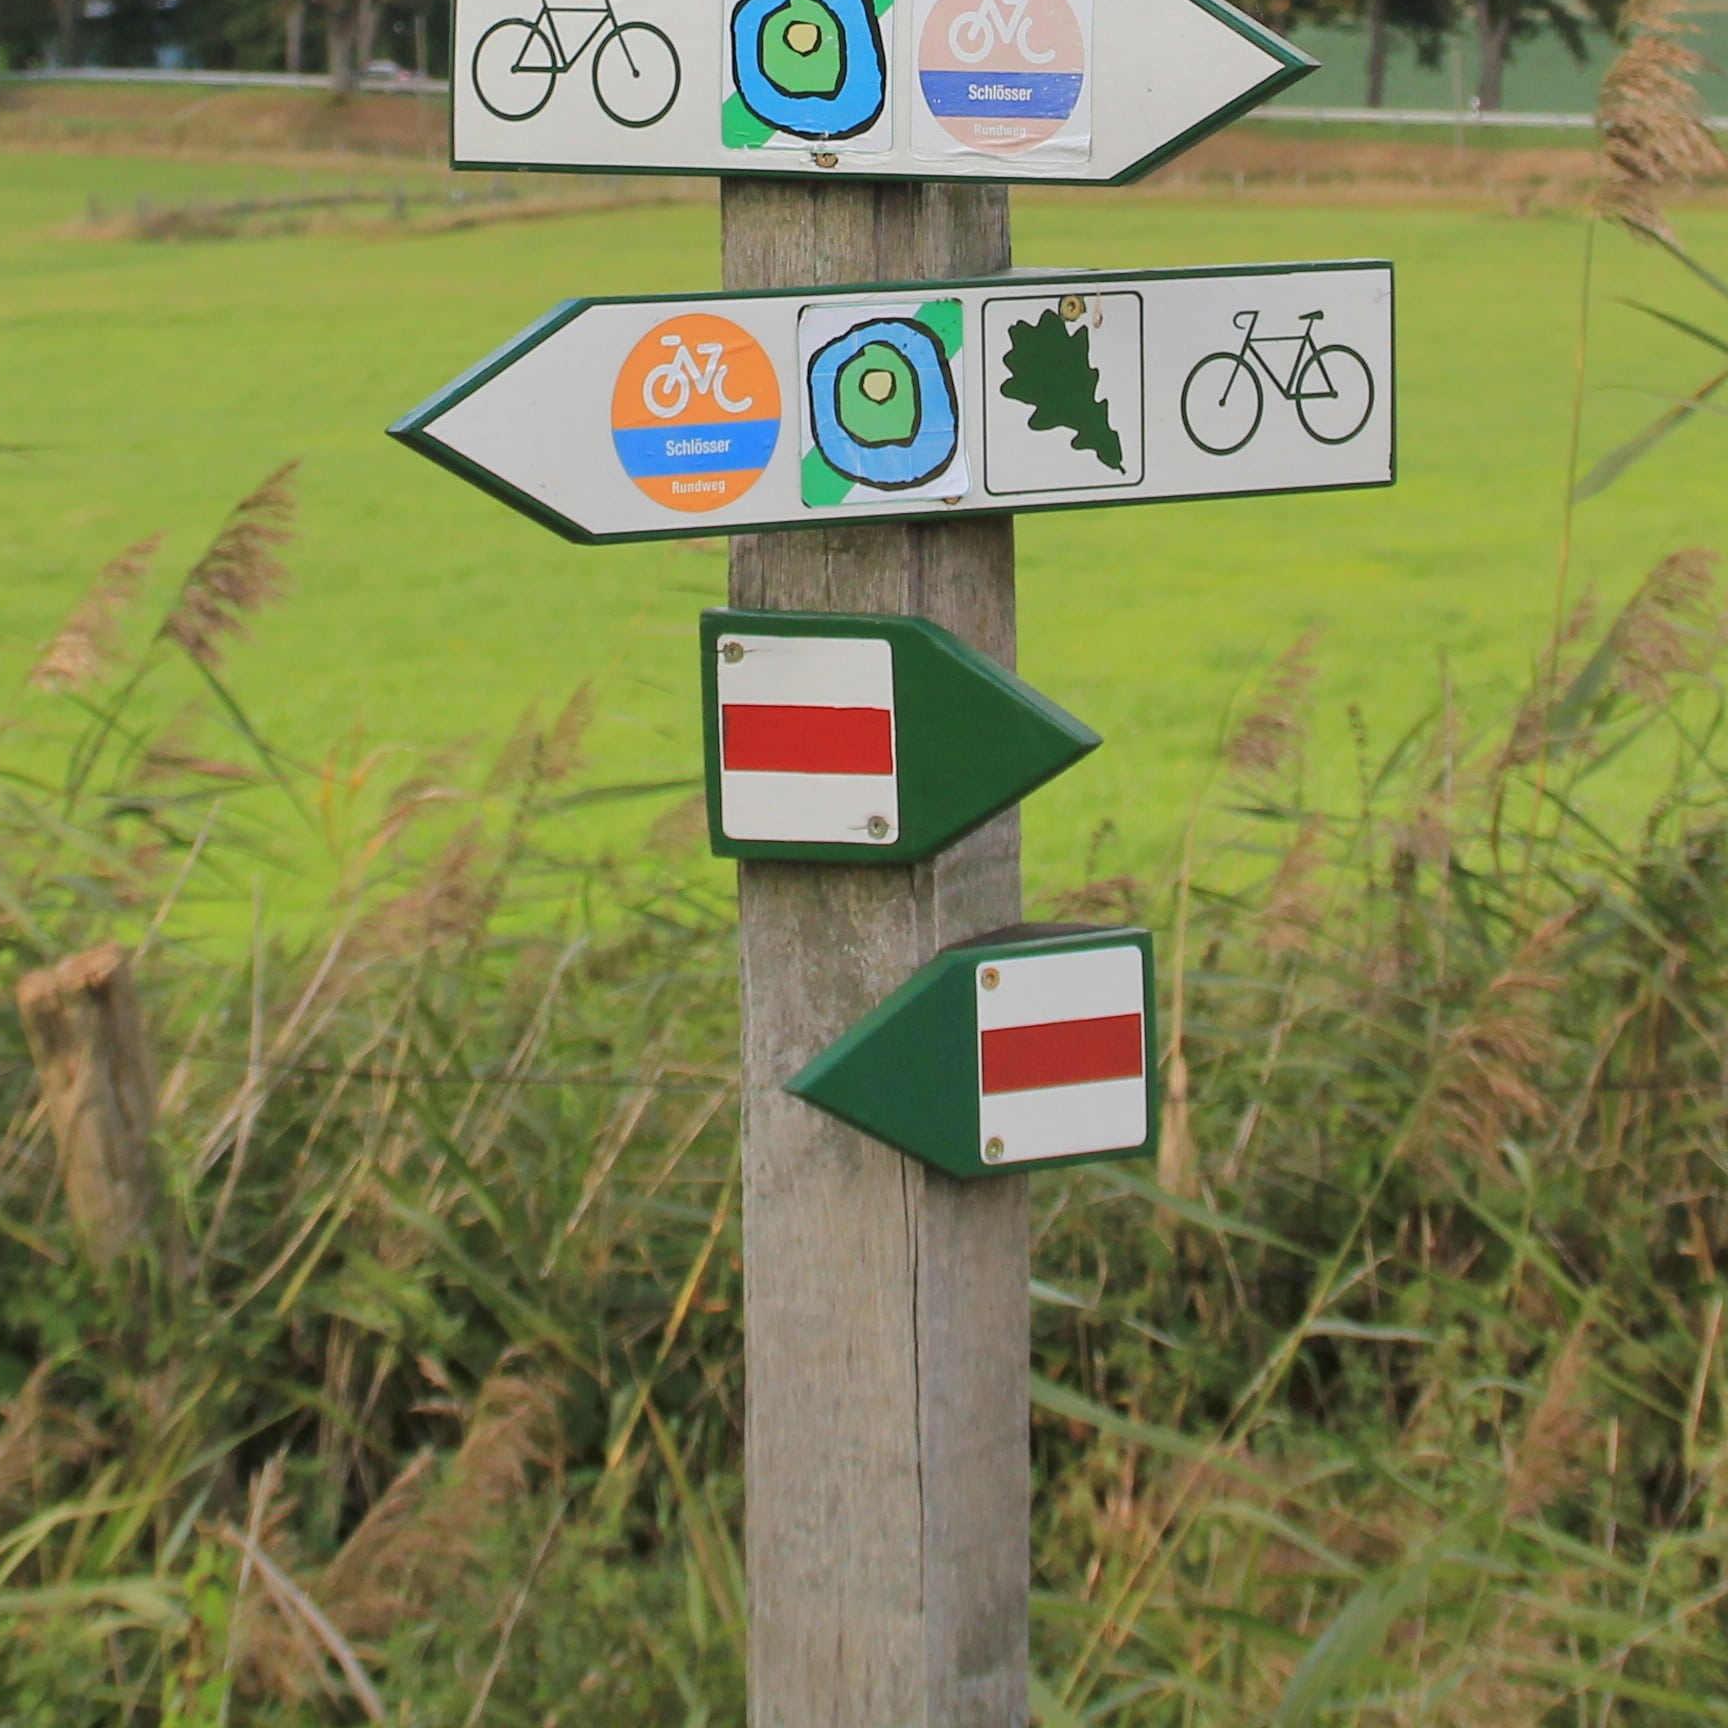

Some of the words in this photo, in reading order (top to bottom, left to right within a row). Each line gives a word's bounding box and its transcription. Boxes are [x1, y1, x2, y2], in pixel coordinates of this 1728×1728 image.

[968, 84, 1032, 101] Schlösser
[974, 125, 1026, 138] Rundweg
[666, 439, 731, 456] Schlösser
[673, 480, 725, 493] Rundweg
